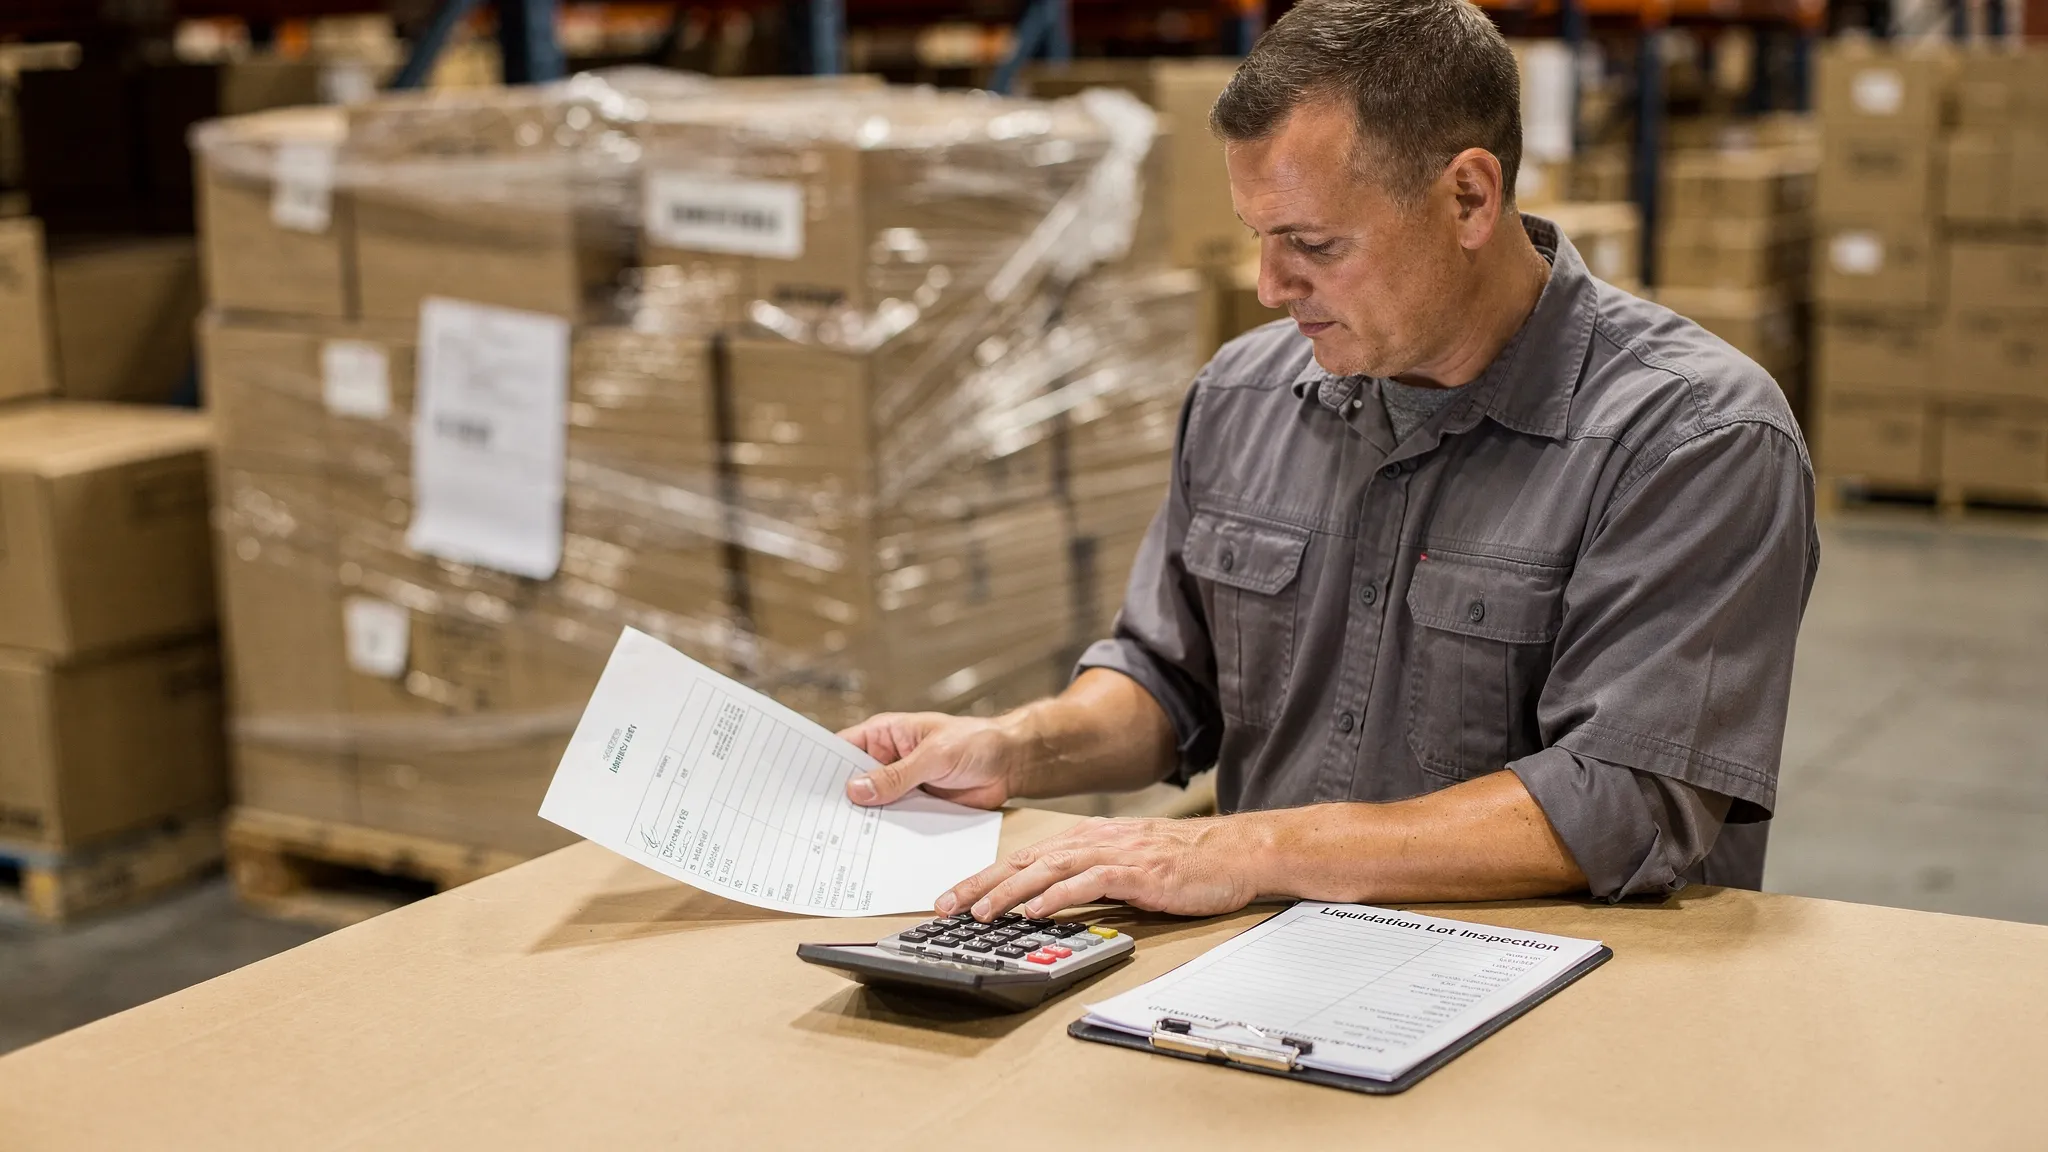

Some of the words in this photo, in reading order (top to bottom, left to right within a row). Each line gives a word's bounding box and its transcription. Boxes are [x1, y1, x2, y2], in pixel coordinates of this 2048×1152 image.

[1320, 907, 1421, 930] Liquidation
[1426, 923, 1456, 936] Lot
[1460, 929, 1559, 952] Inspection
